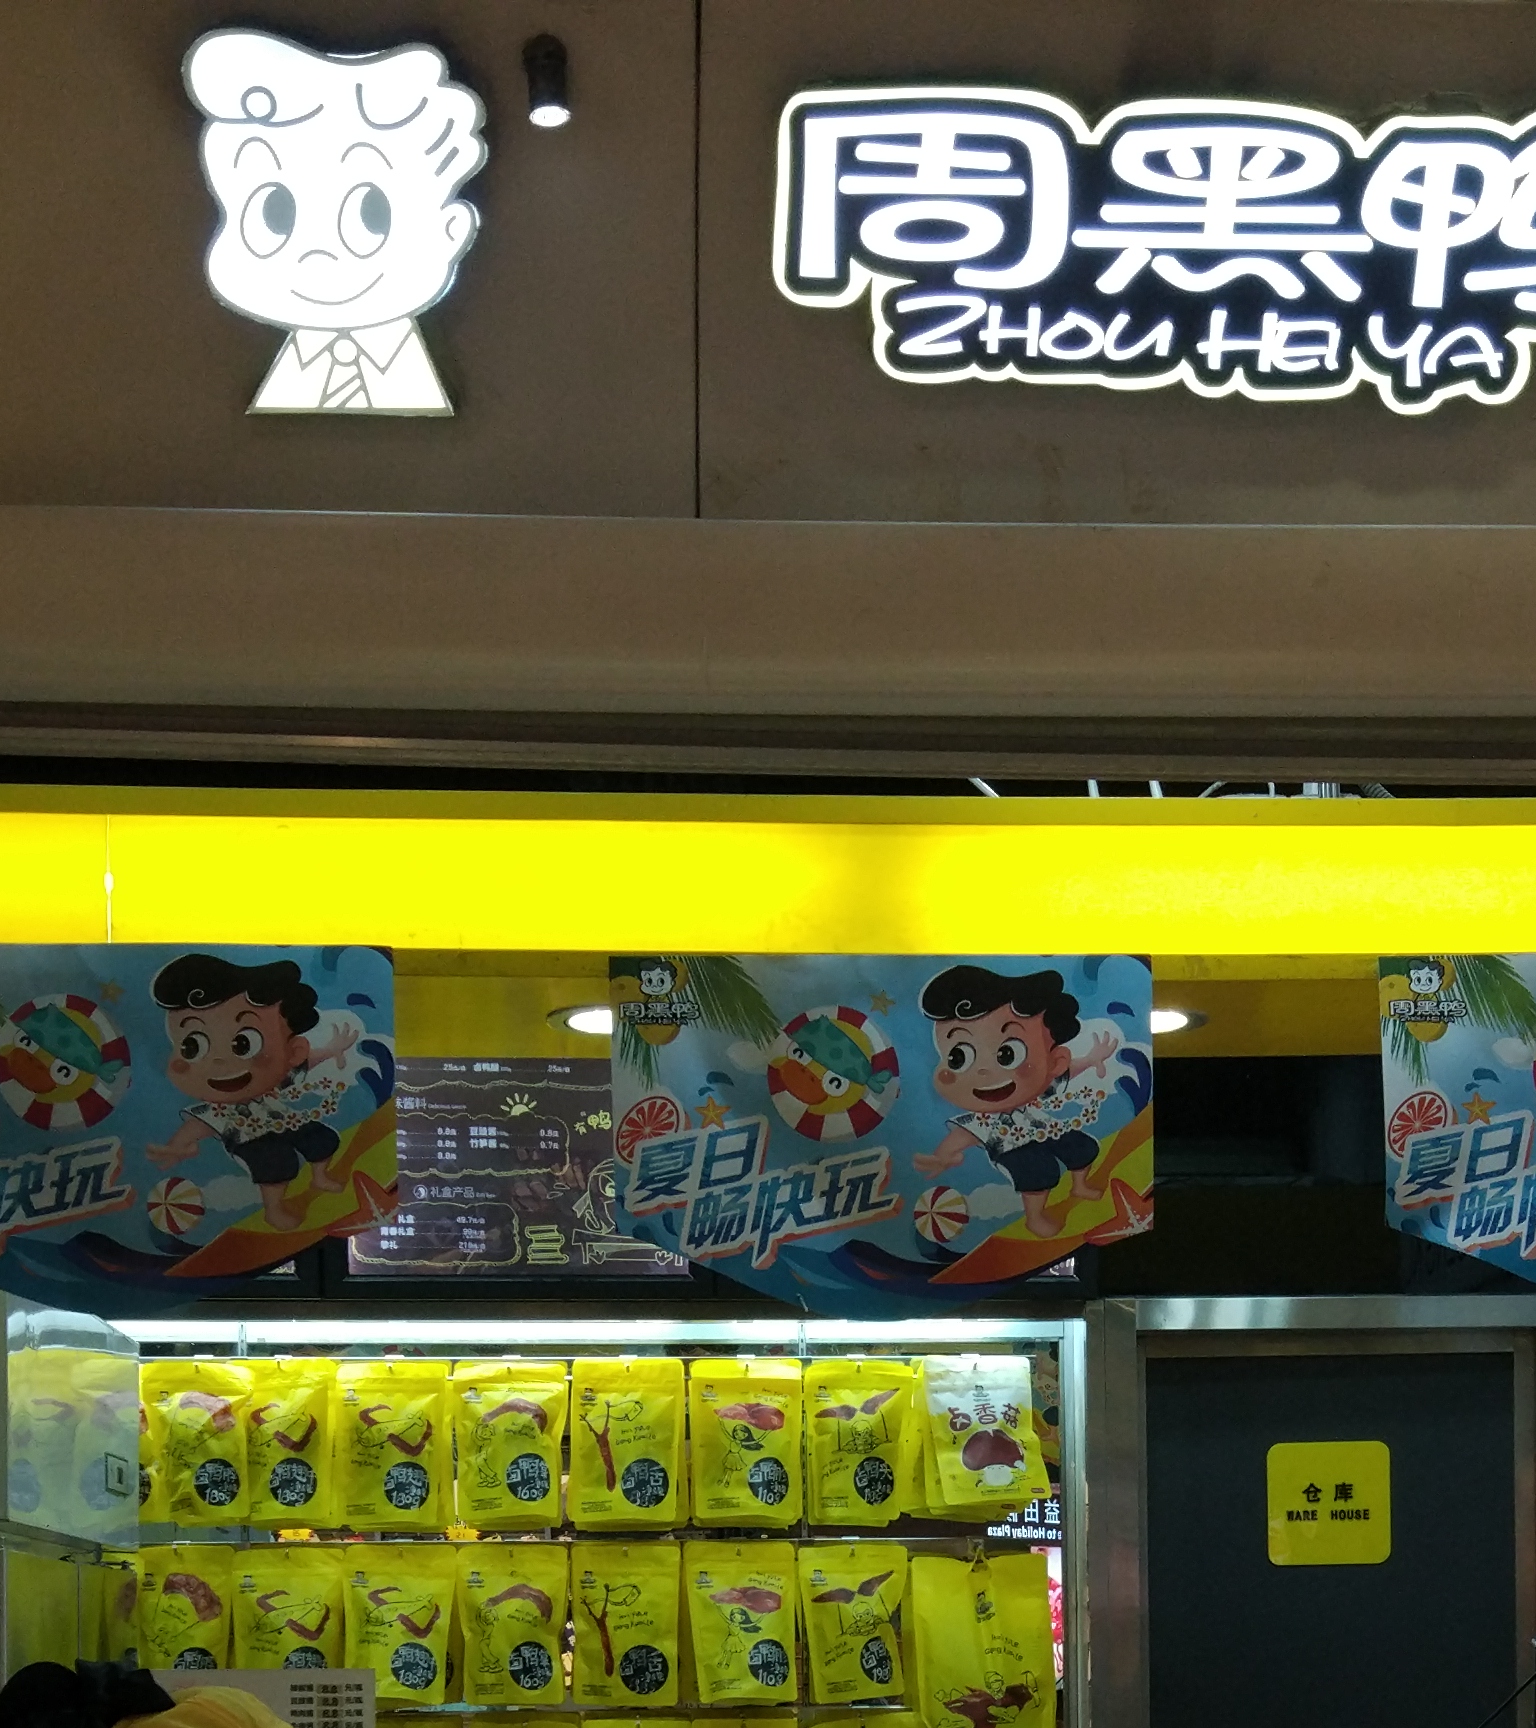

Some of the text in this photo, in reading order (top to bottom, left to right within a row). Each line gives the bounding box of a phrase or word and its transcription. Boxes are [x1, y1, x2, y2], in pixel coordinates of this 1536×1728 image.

[895, 292, 1505, 389] ZHOU HEI YA
[618, 1000, 701, 1021] 周黑鸭
[1388, 999, 1469, 1018] 周黑鸭
[633, 1124, 759, 1204] 夏日
[1403, 1118, 1525, 1197] 夏日
[430, 1185, 476, 1199] 礼盒产品
[686, 1150, 898, 1260] 畅快玩
[1301, 1482, 1355, 1503] 仓库
[1285, 1508, 1371, 1521] WARE HOUSE
